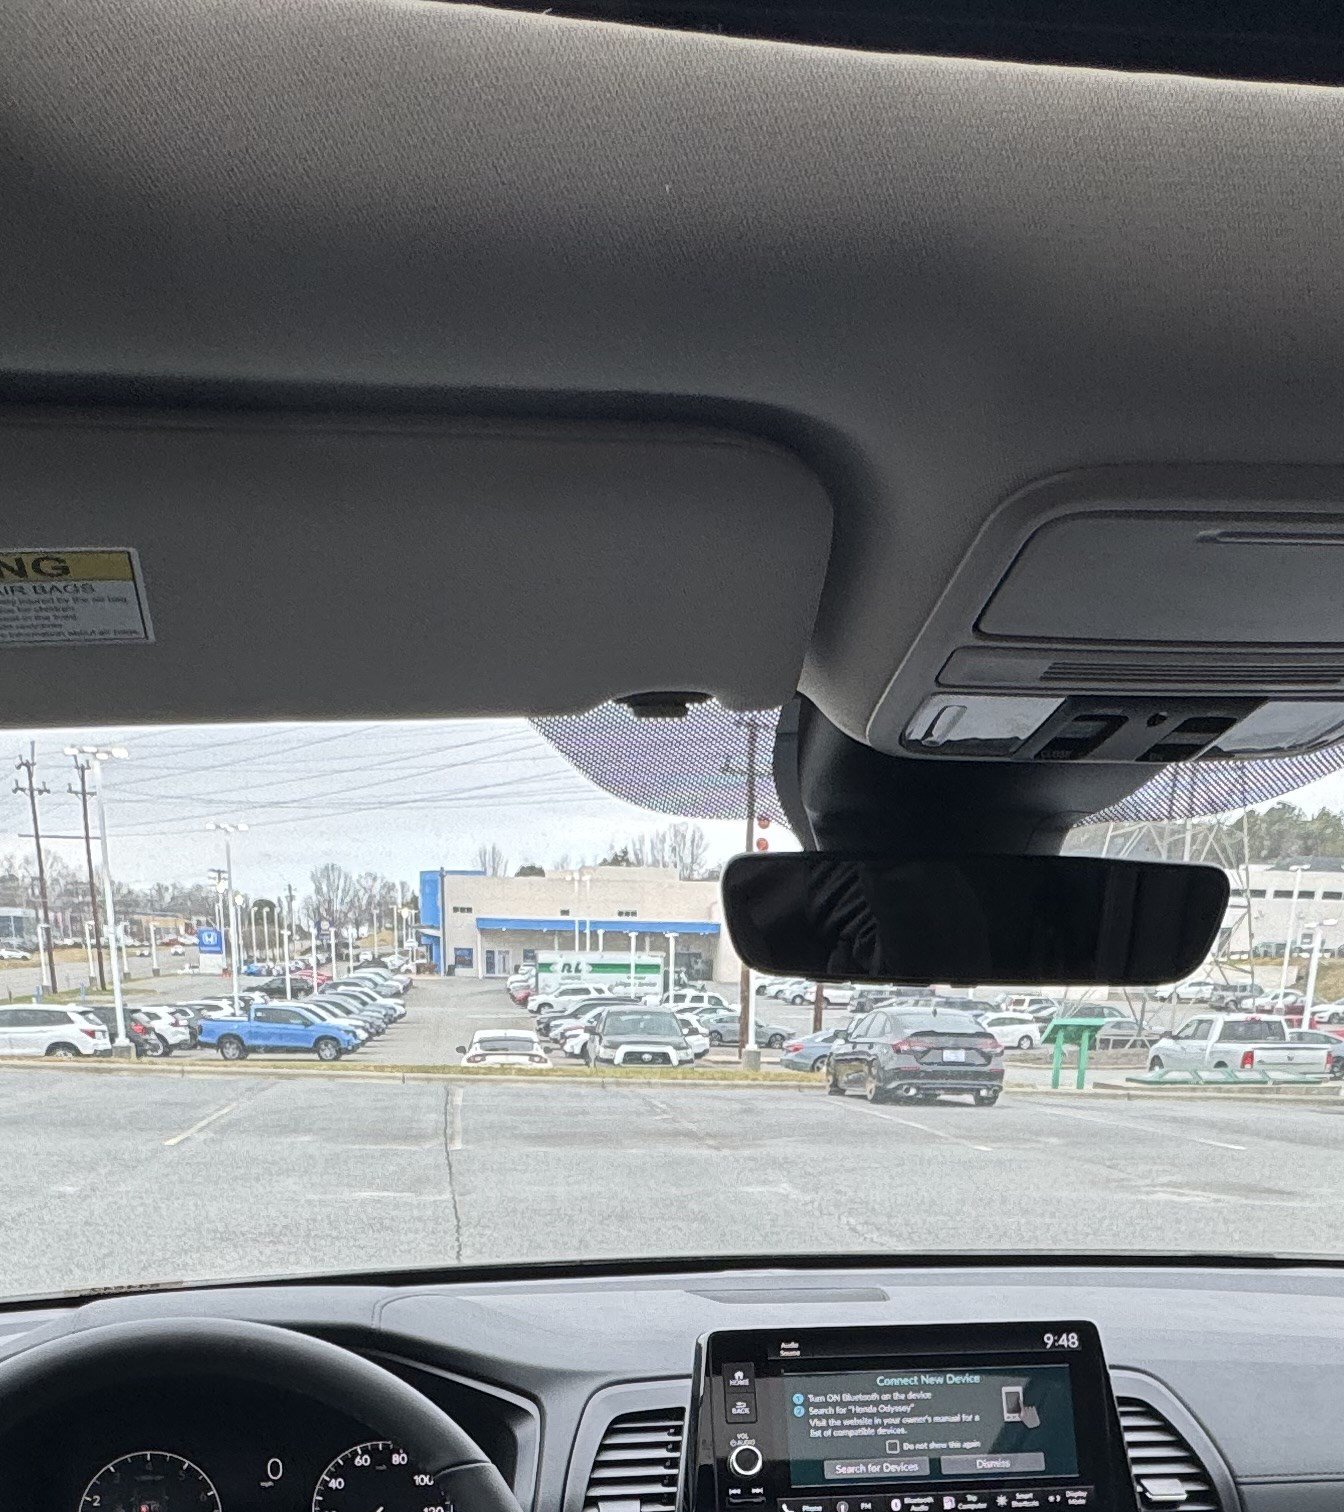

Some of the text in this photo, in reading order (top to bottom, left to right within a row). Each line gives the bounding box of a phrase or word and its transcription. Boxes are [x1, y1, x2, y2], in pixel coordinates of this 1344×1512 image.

[32, 583, 96, 596] BAGS
[1043, 1332, 1079, 1349] 9:48
[729, 1378, 750, 1387] HOME
[876, 1373, 981, 1387] Connect New Device
[807, 1394, 826, 1403] Turn
[827, 1393, 841, 1402] ON
[842, 1392, 879, 1401] Bluetooth
[893, 1391, 905, 1400] the
[907, 1391, 932, 1400] device
[731, 1407, 750, 1415] BACK
[809, 1406, 835, 1415] Search
[836, 1405, 847, 1414] for
[878, 1403, 915, 1414] Odyssey"
[809, 1418, 827, 1427] Visit
[828, 1417, 842, 1426] the
[843, 1417, 873, 1426] website
[874, 1416, 882, 1425] in
[883, 1417, 901, 1427] your
[902, 1415, 932, 1424] owner's
[933, 1413, 961, 1423] manual
[962, 1413, 973, 1422] for
[823, 1428, 832, 1437] of
[833, 1427, 875, 1438] compatible
[877, 1426, 908, 1436] devices.
[902, 1440, 982, 1451] Do not show this again
[354, 1454, 371, 1467] 60
[392, 1453, 408, 1465] 80
[976, 1459, 1011, 1470] Dismiss
[267, 1458, 283, 1480] 0
[835, 1462, 919, 1475] Search for Devices
[328, 1478, 345, 1490] 40
[92, 1495, 101, 1506] 2
